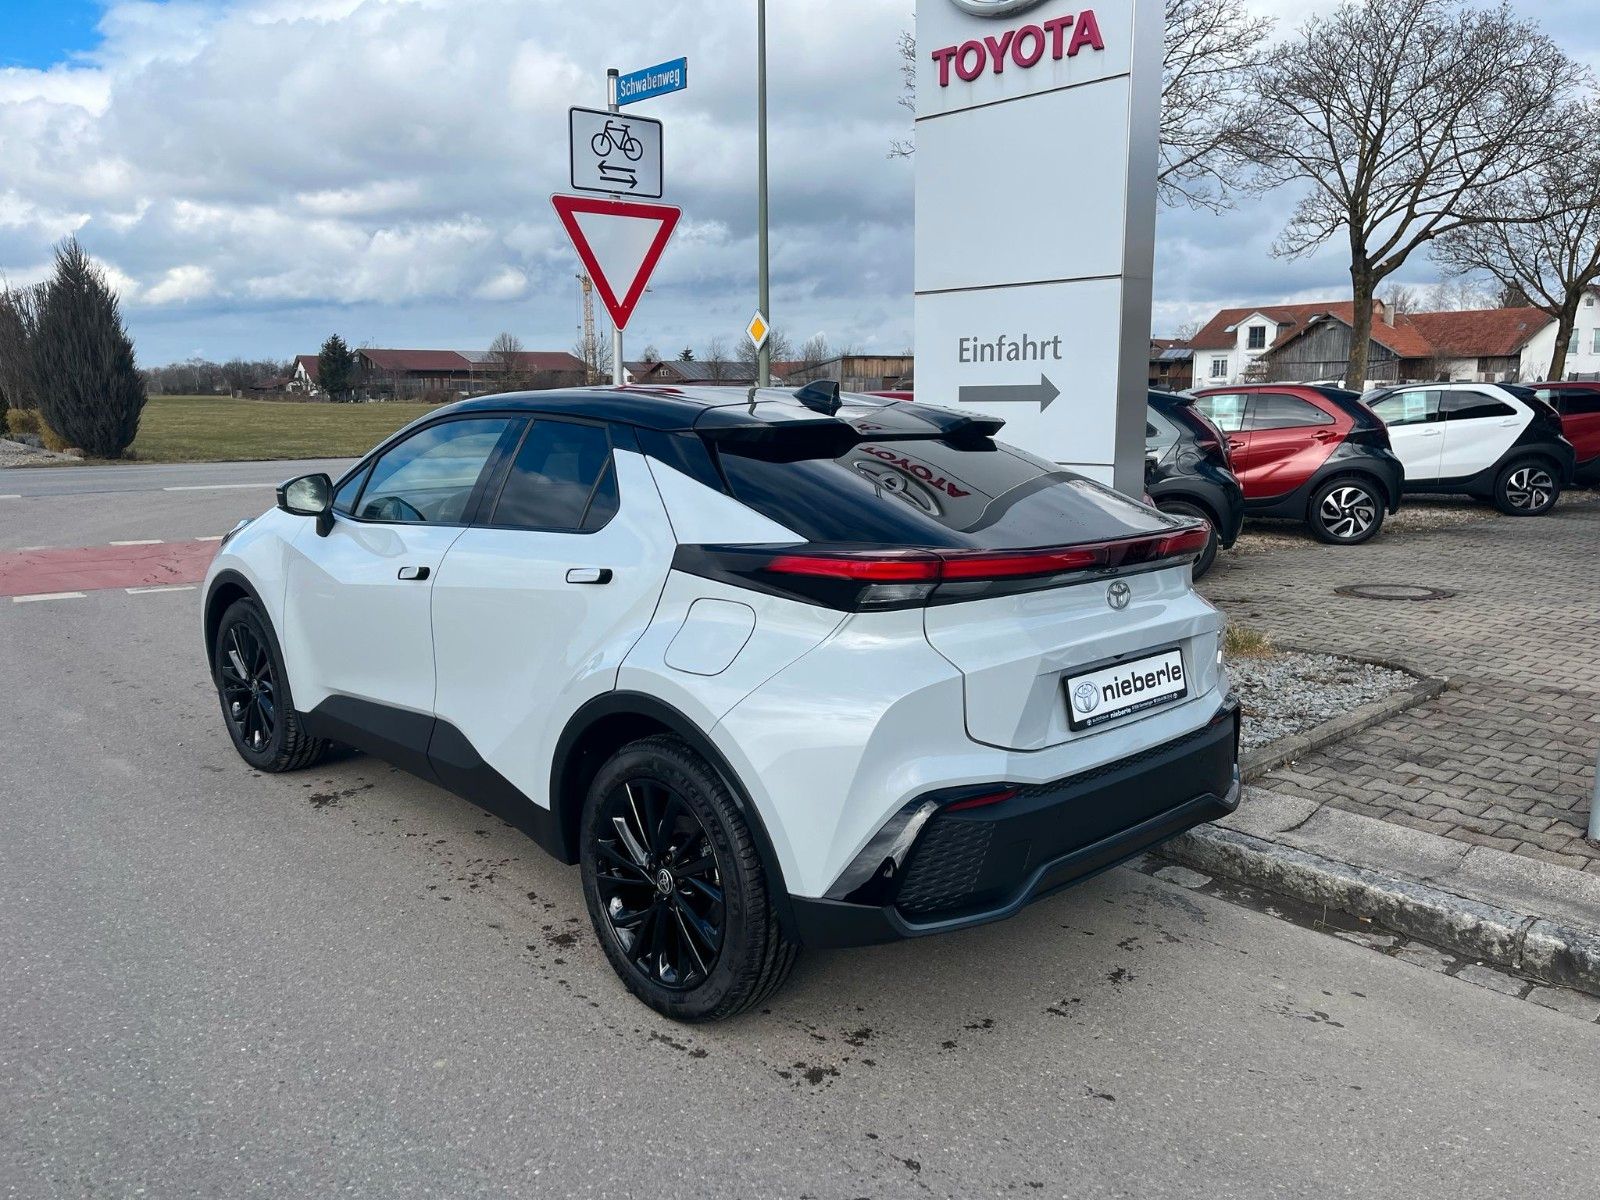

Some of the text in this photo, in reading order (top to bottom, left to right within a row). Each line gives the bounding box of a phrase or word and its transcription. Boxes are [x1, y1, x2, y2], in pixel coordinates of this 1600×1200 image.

[931, 9, 1104, 87] TOYOTA
[620, 68, 680, 97] Schwabenweg
[958, 333, 1062, 363] Einfahrt
[1102, 662, 1182, 702] nieberle
